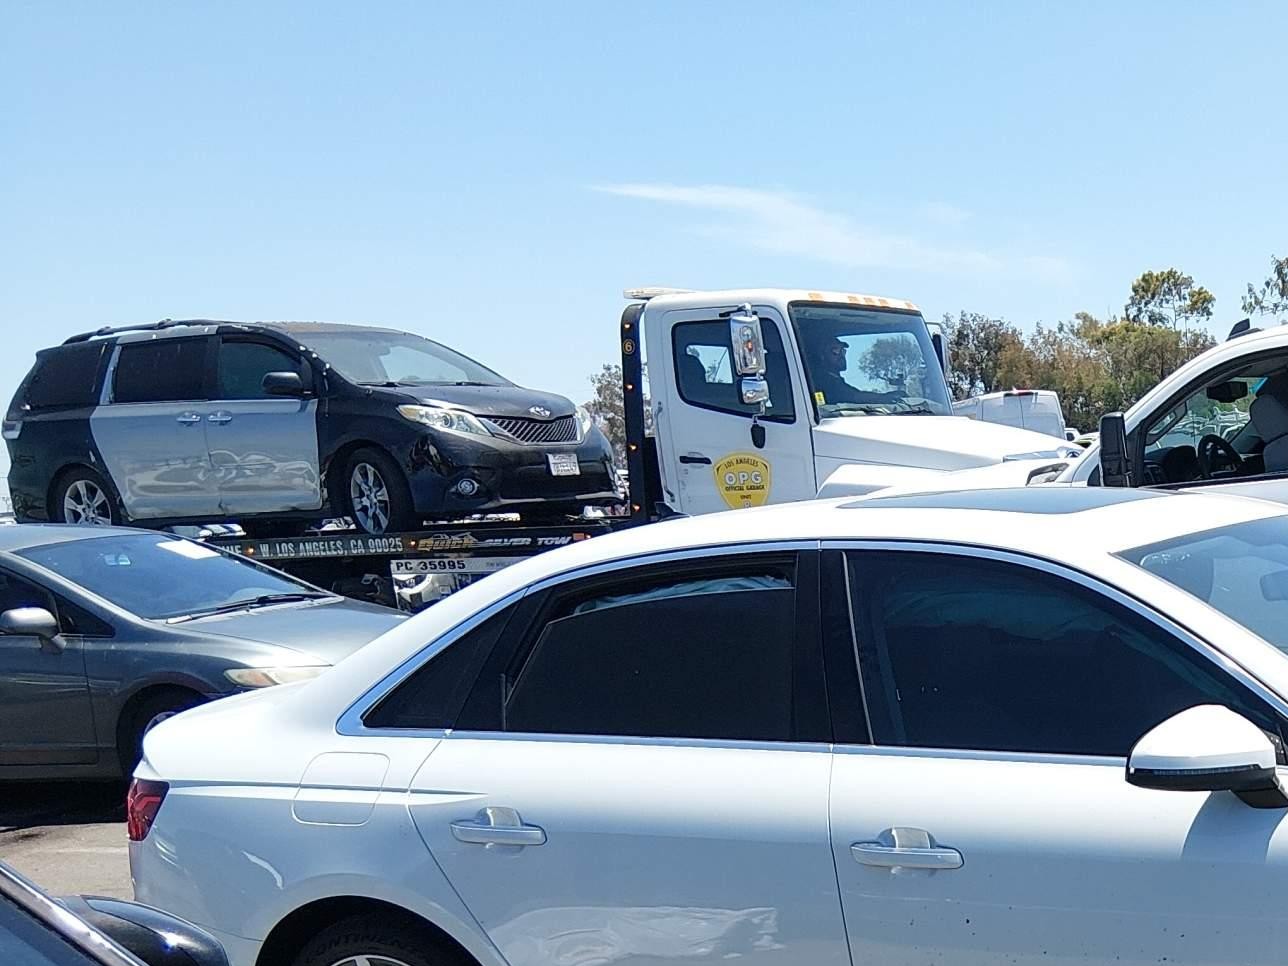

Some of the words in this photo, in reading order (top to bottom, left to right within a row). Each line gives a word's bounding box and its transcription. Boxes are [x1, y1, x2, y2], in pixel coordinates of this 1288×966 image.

[625, 341, 632, 352] 6
[724, 461, 735, 469] LOS
[736, 458, 759, 467] ANGELES
[725, 471, 762, 485] OPG
[536, 536, 572, 546] TOW
[260, 543, 274, 557] W.
[276, 542, 295, 557] LOS
[299, 541, 348, 557] ANGELES,
[350, 539, 366, 554] CA
[368, 537, 404, 553] 90025
[395, 561, 413, 571] PC
[416, 560, 466, 570] 35995
